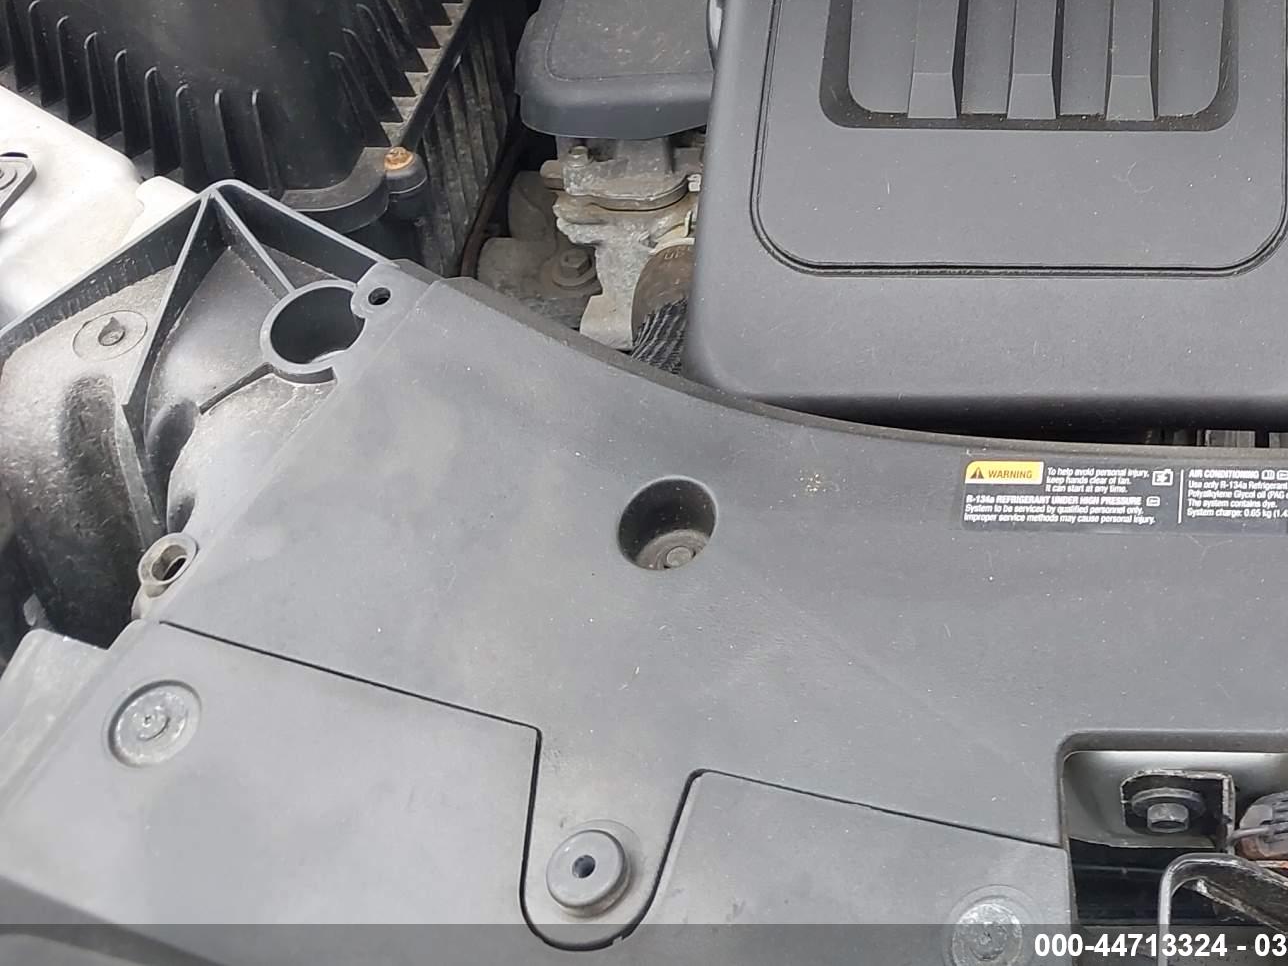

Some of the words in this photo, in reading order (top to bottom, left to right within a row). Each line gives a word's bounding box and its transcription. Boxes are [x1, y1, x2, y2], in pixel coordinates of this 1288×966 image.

[988, 470, 1032, 479] WARNING
[1048, 467, 1056, 476] To
[1057, 468, 1074, 478] help
[1074, 468, 1094, 476] avoid
[1095, 468, 1126, 478] personal
[1128, 468, 1150, 478] injury.
[1189, 469, 1202, 478] AIR
[1204, 470, 1260, 479] CONDITIONING
[1066, 476, 1088, 484] hands
[1188, 480, 1202, 488] Use
[1203, 480, 1219, 490] only
[1248, 481, 1288, 490] Refrigerant
[1068, 484, 1084, 492] start
[1094, 486, 1108, 494] any
[996, 495, 1050, 504] REFRIGERANT
[1051, 496, 1079, 504] UNDER
[1080, 496, 1100, 504] HIGH
[1100, 496, 1142, 505] PRESSURE
[1234, 490, 1256, 500] Glycol
[1256, 491, 1266, 499] oil
[1188, 498, 1202, 506] The
[1202, 500, 1229, 508] system
[1230, 500, 1260, 508] contains
[965, 504, 993, 513] System
[994, 504, 1002, 512] to
[1014, 504, 1046, 513] serviced
[1046, 505, 1056, 514] by
[1057, 505, 1089, 514] qualified
[1090, 506, 1126, 515] personnel
[1186, 508, 1214, 518] System
[1262, 509, 1272, 519] kg
[964, 513, 997, 523] Improper
[998, 514, 1026, 522] service
[1026, 514, 1059, 522] methods
[1060, 515, 1076, 524] may
[1100, 515, 1132, 524] personal
